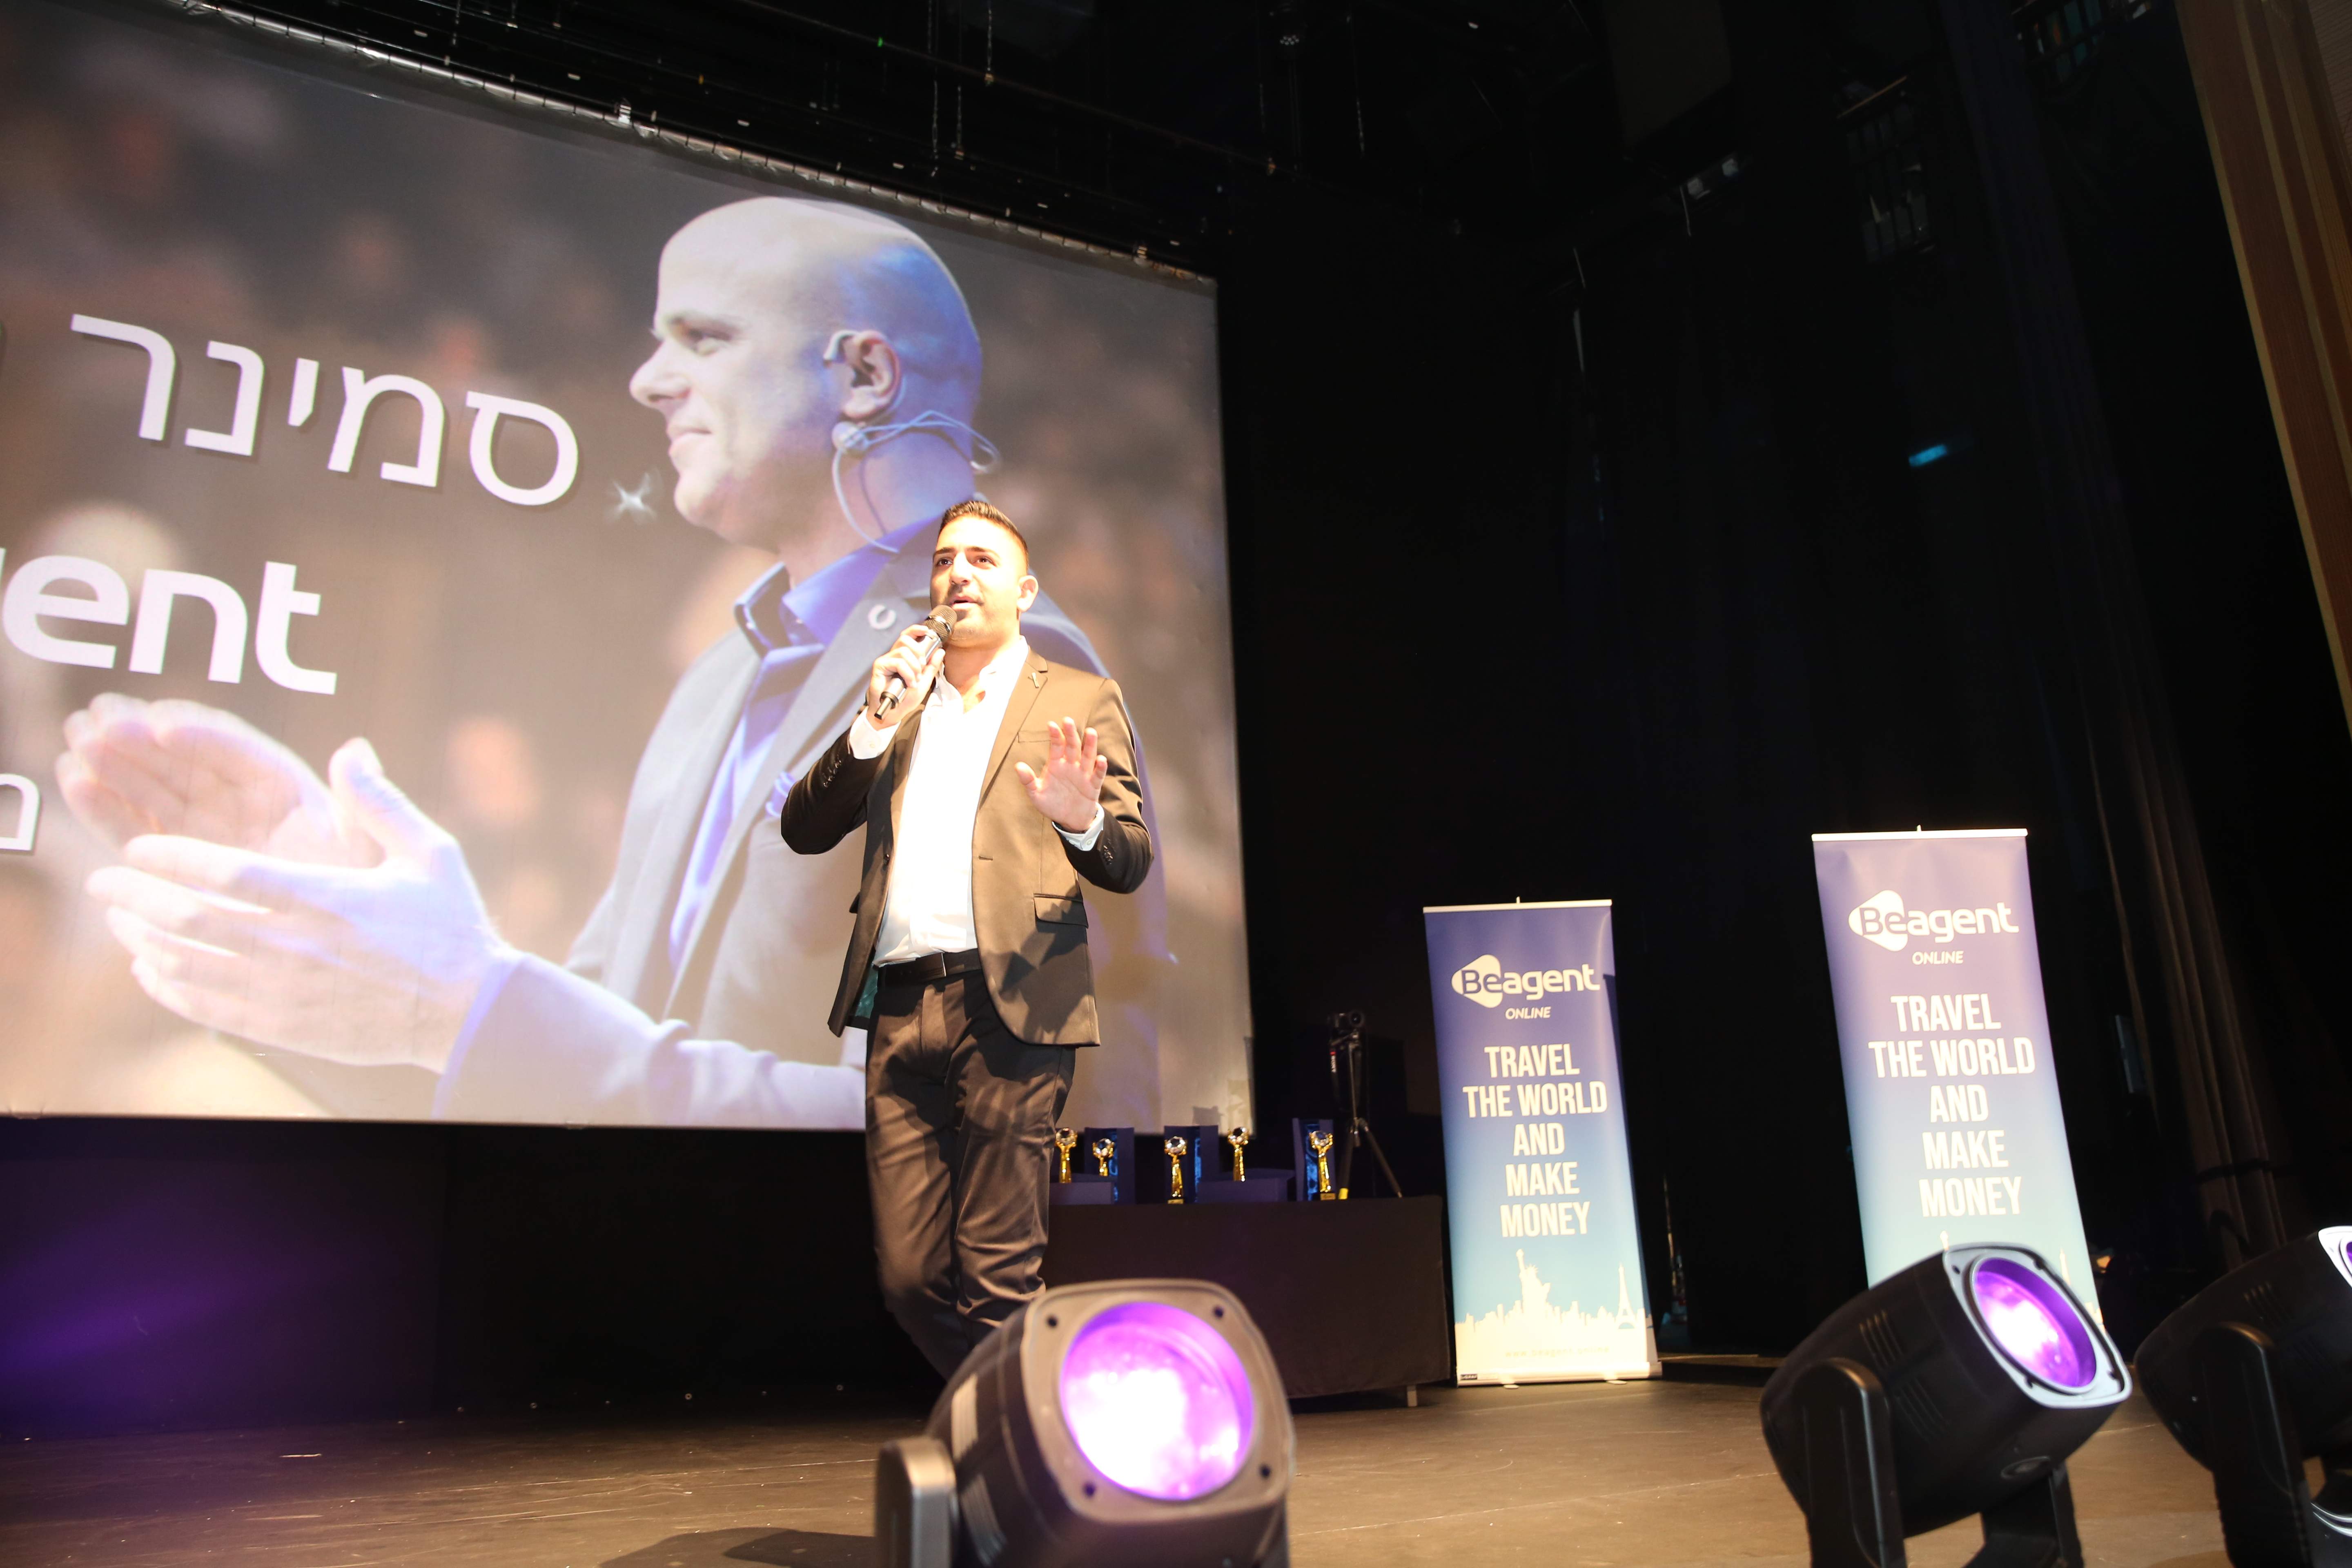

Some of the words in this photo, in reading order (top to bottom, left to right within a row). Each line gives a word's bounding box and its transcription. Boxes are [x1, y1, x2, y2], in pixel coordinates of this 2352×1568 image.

[71, 314, 579, 506] סמינר
[0, 548, 337, 695] ent
[1859, 902, 2019, 943] Beagent
[1912, 951, 1964, 965] ONLINE
[1461, 964, 1600, 1000] Beagent
[1506, 1006, 1551, 1020] ONLINE
[1890, 993, 2001, 1032] TRAVEL
[1484, 1044, 1580, 1078] TRAVEL
[1868, 1040, 1927, 1078] THE
[1930, 1037, 2036, 1076] WORLD
[1463, 1085, 1513, 1118] THE
[1517, 1081, 1608, 1116] WORLD
[1930, 1085, 1989, 1123] AND
[1513, 1123, 1565, 1156] AND
[1922, 1130, 2009, 1169] MAKE
[1506, 1162, 1580, 1196] MAKE
[1919, 1176, 2021, 1217] MONEY
[1500, 1201, 1590, 1237] MONEY
